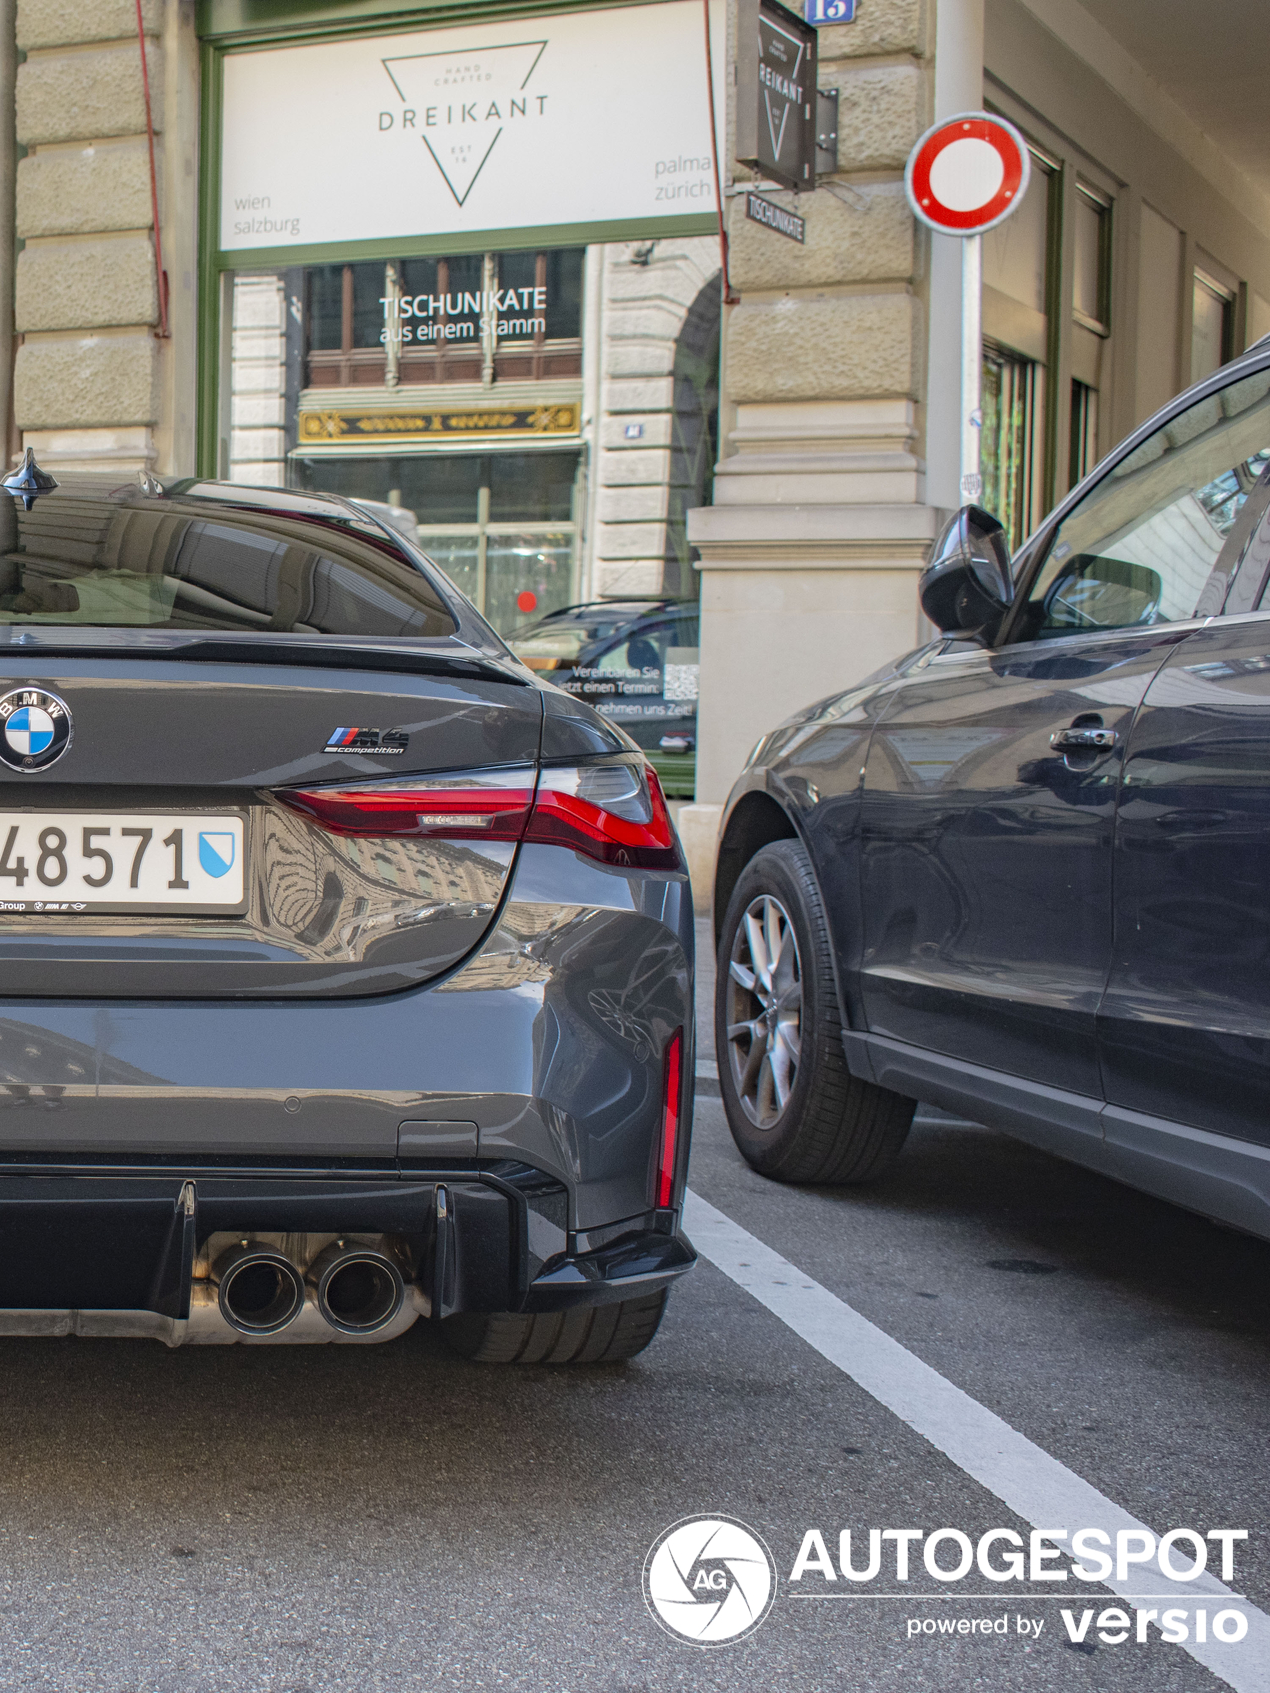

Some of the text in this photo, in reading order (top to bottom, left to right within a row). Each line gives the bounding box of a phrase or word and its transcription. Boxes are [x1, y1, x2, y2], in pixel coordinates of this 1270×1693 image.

[445, 64, 481, 75] HAND
[434, 73, 492, 87] CRAFTED
[759, 63, 803, 104] REIKANT
[379, 95, 548, 131] DREIKANT
[655, 155, 711, 179] palma
[655, 179, 711, 201] zürich
[234, 194, 271, 211] wien
[233, 216, 301, 236] salzburg
[749, 195, 803, 240] TISCHUNIKATE
[379, 286, 547, 319] TISCHUNIKATE
[379, 317, 546, 343] aus einem Stamm
[572, 666, 660, 679] Vereinbaren Sie
[583, 682, 615, 693] einen
[616, 682, 660, 694] Termin:
[595, 702, 642, 715] nehmen
[644, 705, 665, 715] uns
[667, 703, 693, 716] Zeit!
[337, 746, 405, 755] competition
